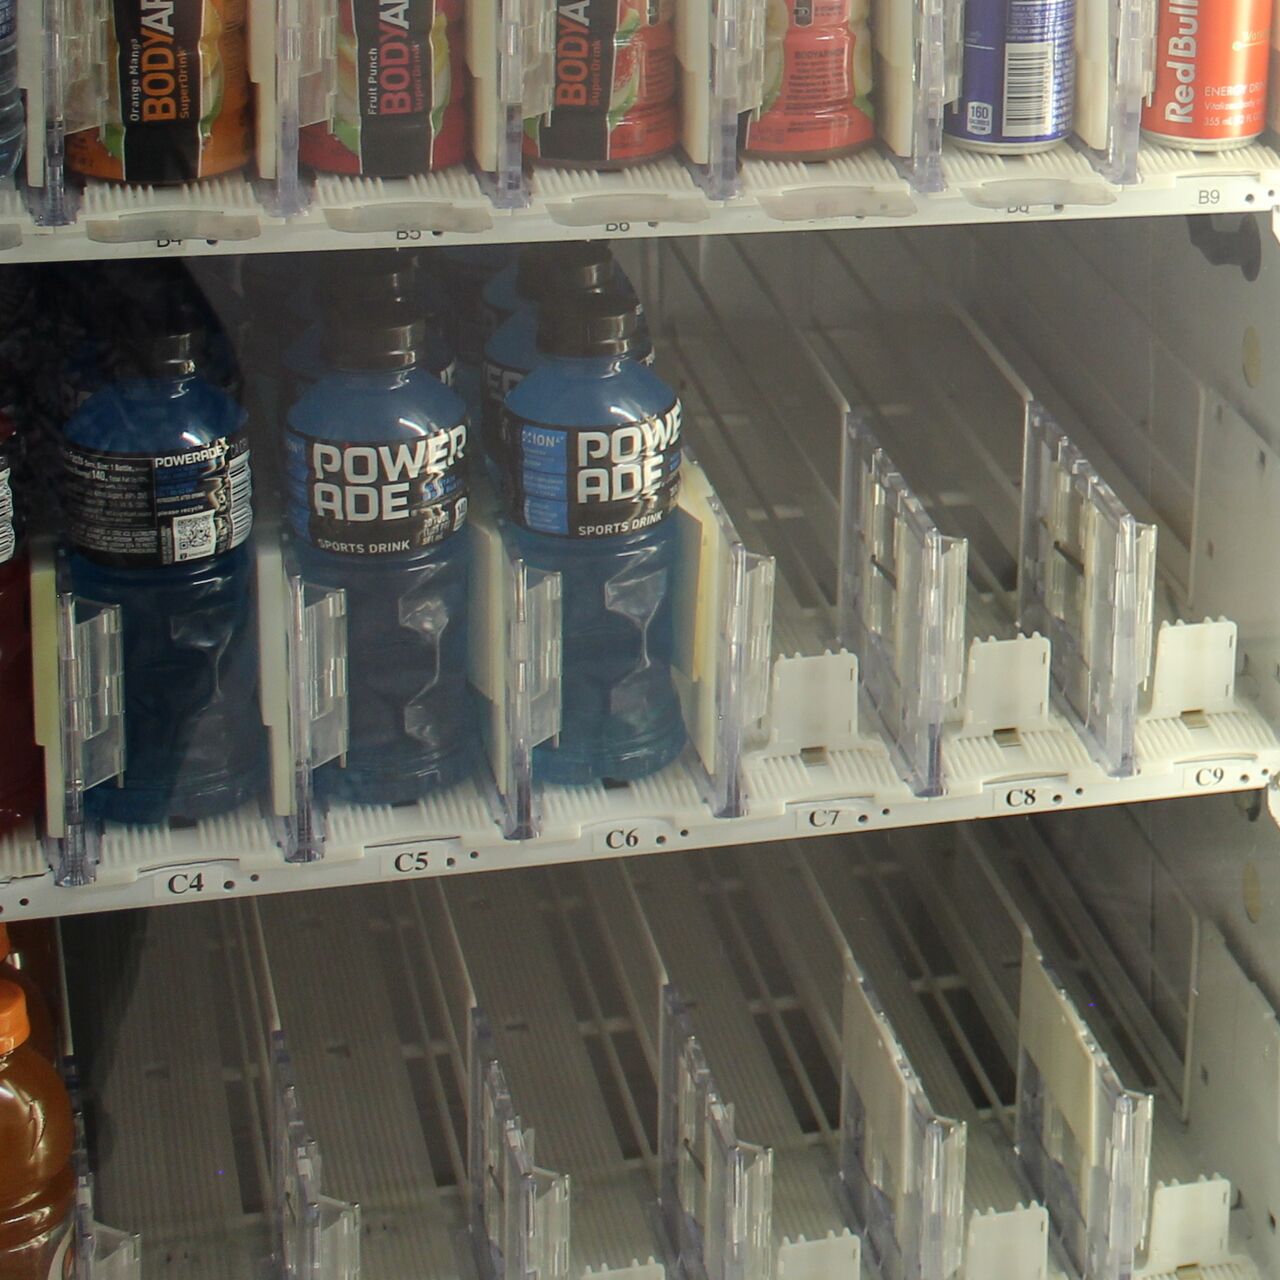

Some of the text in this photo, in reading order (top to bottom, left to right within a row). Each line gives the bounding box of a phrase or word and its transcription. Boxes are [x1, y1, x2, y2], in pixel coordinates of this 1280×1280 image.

[129, 37, 143, 122] Orange Mango
[368, 47, 378, 115] Fruit Punch
[1165, 61, 1197, 123] Red
[970, 105, 989, 119] 160
[1198, 190, 1220, 205] B9
[577, 397, 682, 467] POWE
[154, 449, 224, 469] POWERADE
[312, 424, 468, 484] POWER
[577, 455, 664, 504] ADE
[313, 482, 411, 522] ADE
[578, 510, 664, 536] SPORTS DRINK
[318, 538, 411, 554] SPORTS DRINK
[1195, 767, 1225, 787] C9
[1006, 788, 1037, 808] C8
[809, 810, 841, 828] C7
[605, 827, 639, 850] C6
[394, 852, 429, 873] C5
[168, 873, 205, 895] C4
